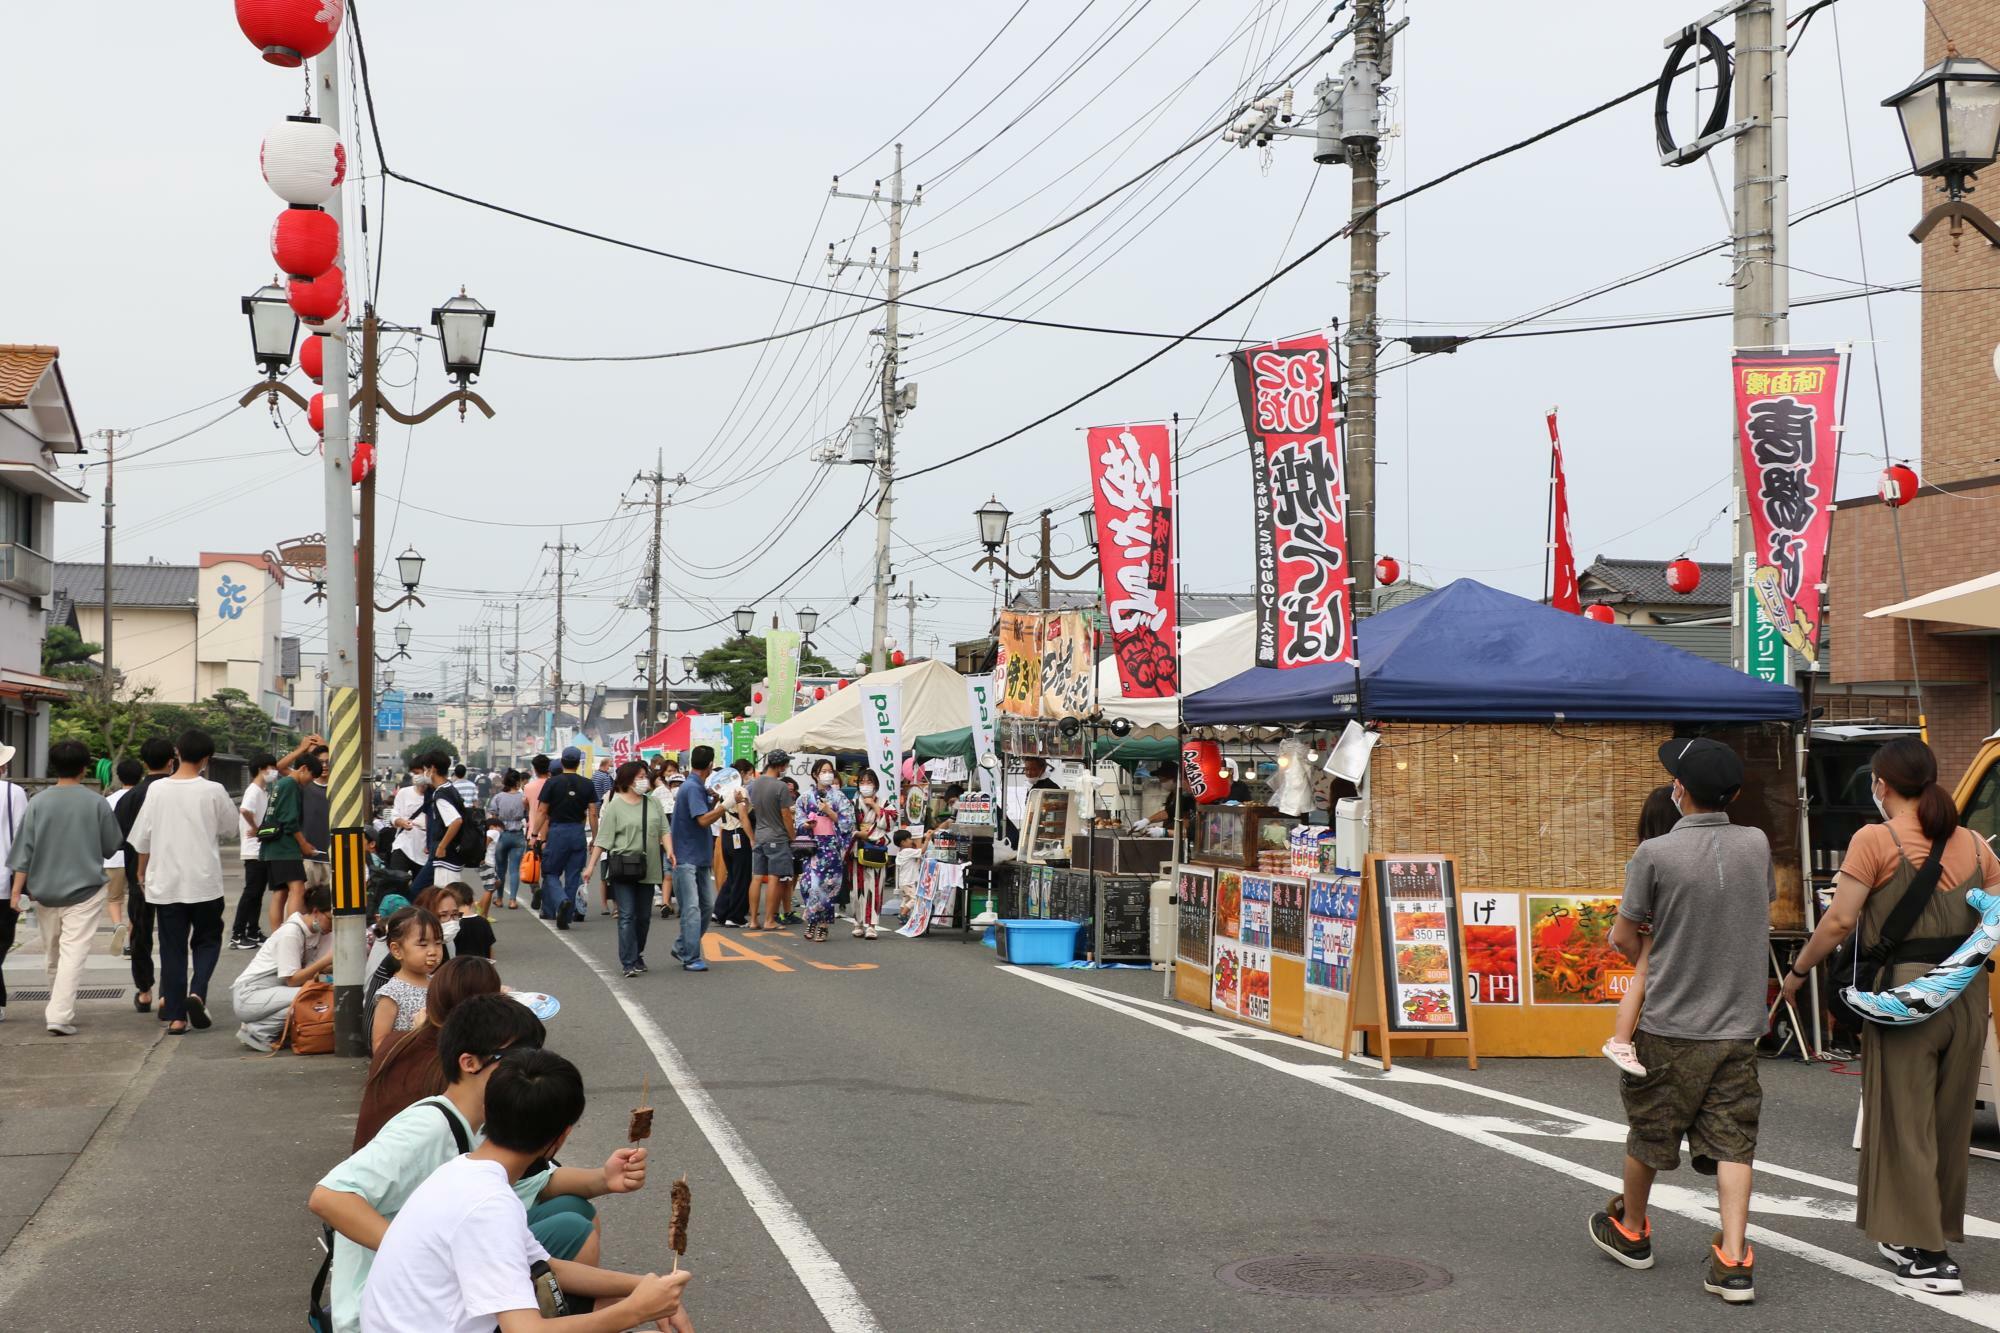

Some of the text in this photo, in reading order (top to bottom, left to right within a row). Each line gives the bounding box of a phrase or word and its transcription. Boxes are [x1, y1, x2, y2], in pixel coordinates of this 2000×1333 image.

[216, 575, 247, 619] ふとん
[869, 694, 896, 734] pal
[974, 686, 993, 730] pal
[1314, 888, 1346, 916] かき氷
[1474, 898, 1497, 924] げ
